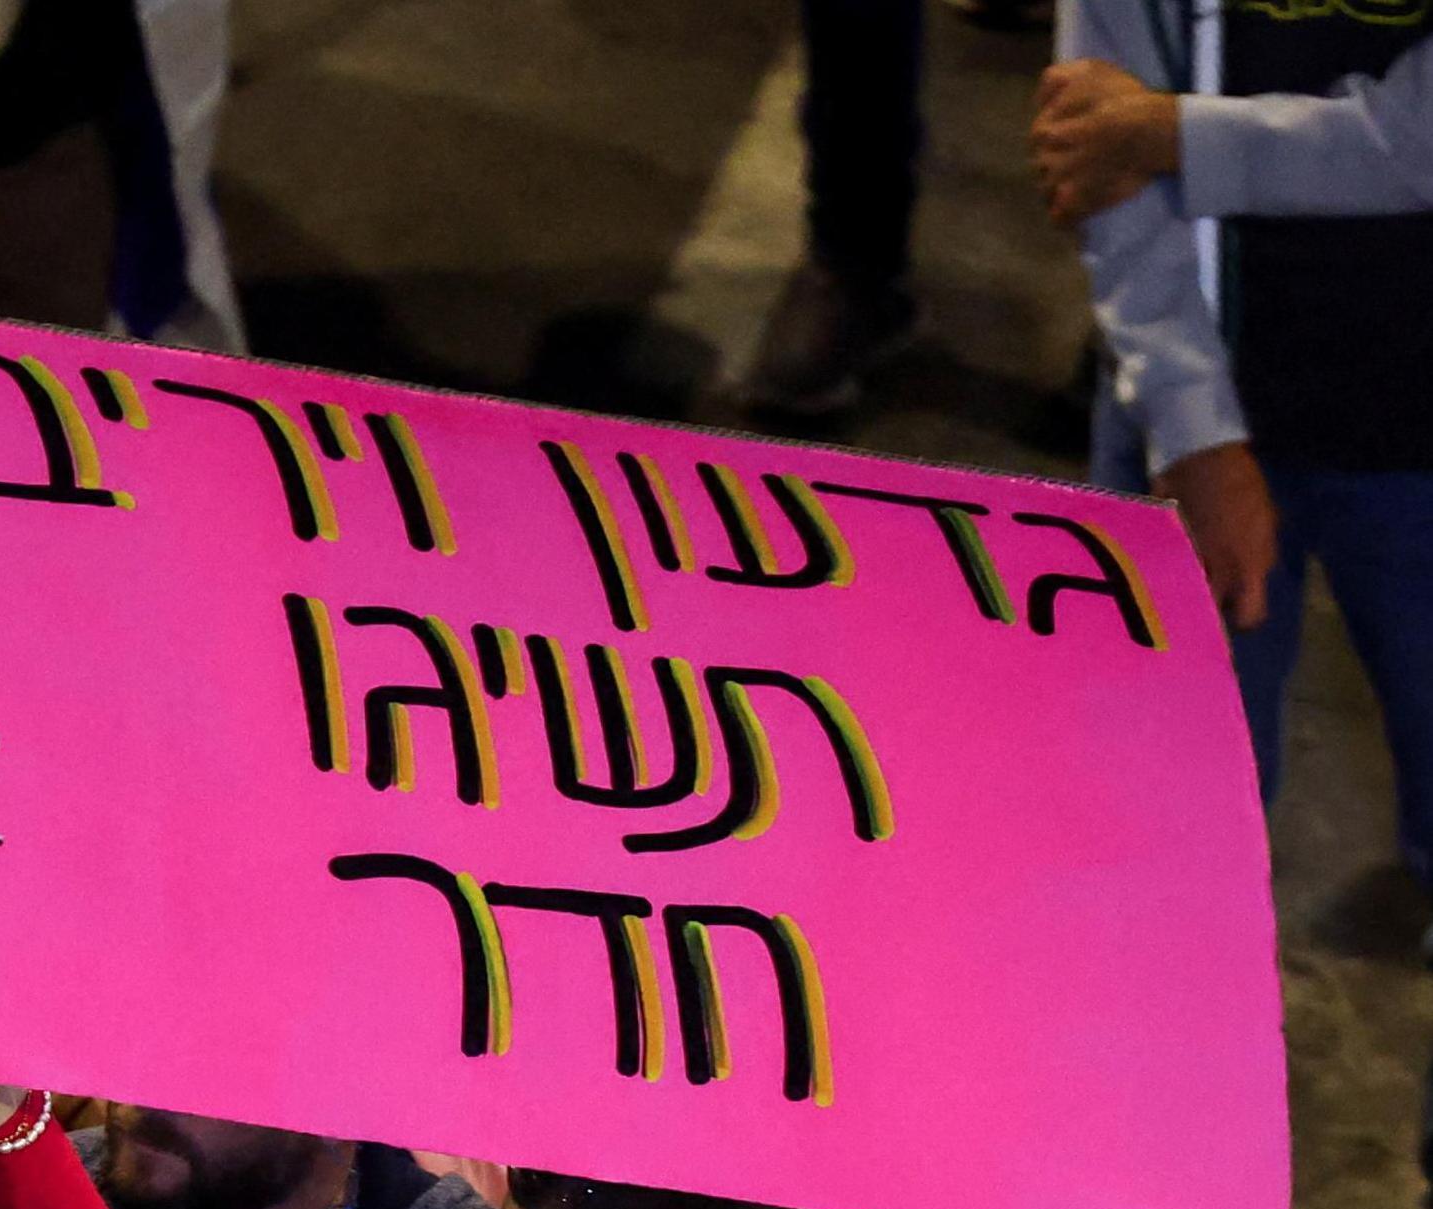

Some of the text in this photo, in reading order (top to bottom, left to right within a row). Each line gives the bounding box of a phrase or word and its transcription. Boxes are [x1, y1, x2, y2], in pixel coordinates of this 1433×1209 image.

[541, 439, 1168, 653] גדעון
[284, 592, 896, 854] תשיגו
[329, 852, 837, 1109] חדר
